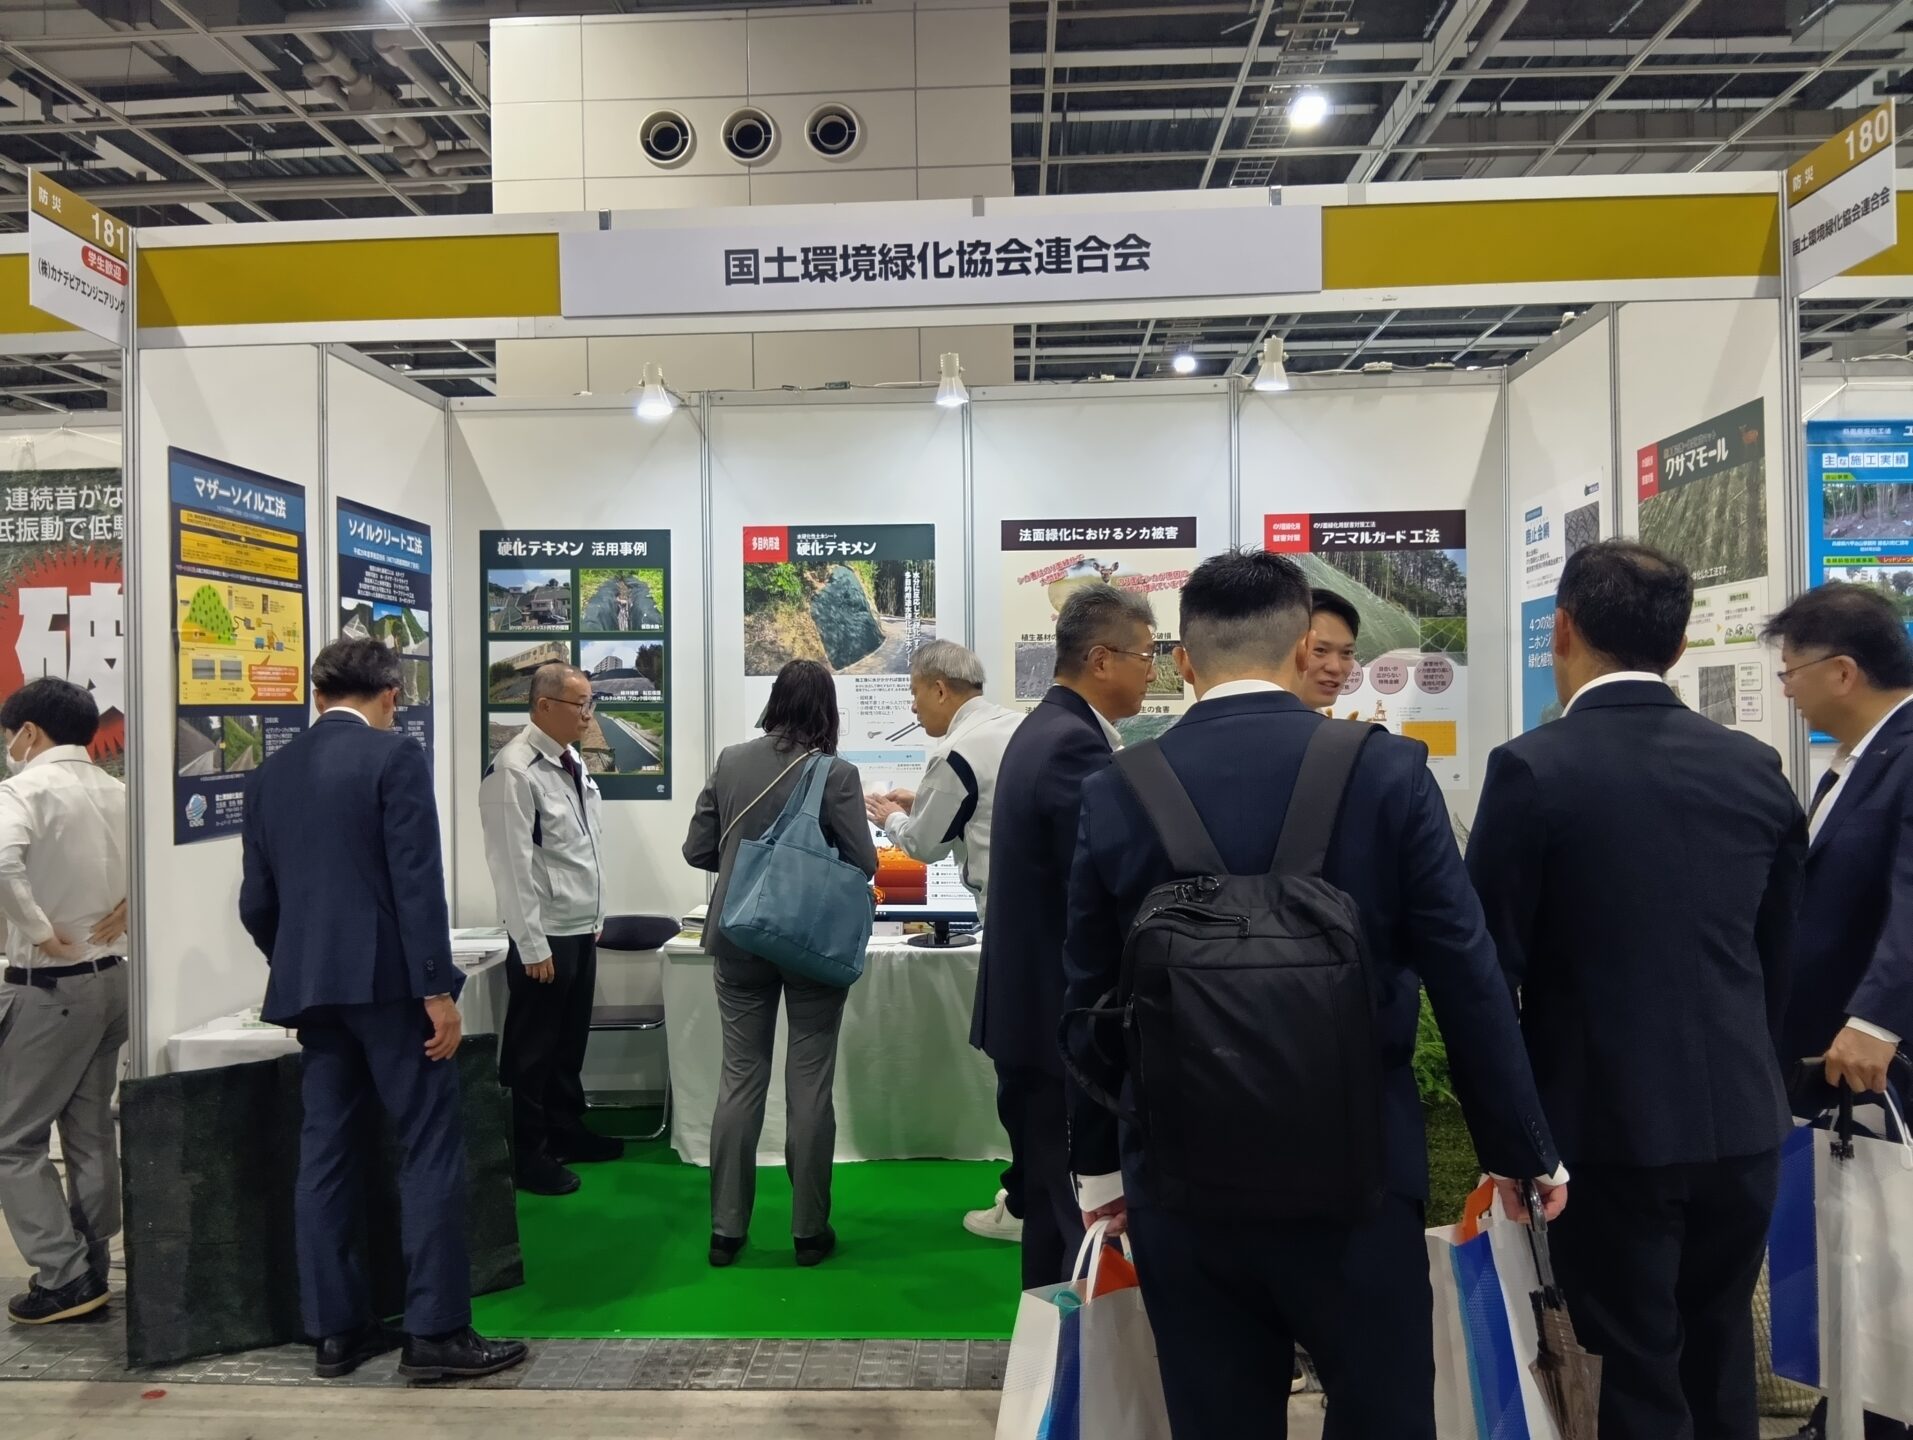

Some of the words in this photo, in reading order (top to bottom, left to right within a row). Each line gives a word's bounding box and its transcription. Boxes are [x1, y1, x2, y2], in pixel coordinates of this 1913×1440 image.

[1845, 109, 1890, 161] 180
[38, 187, 62, 213] 防災
[91, 213, 125, 254] 181
[1792, 186, 1890, 257] 国土環境緑化協会連合会
[87, 250, 122, 282] 学生歓迎
[723, 232, 1152, 287] 国土環境緑化協会連合会
[1665, 437, 1729, 480] クサマモール
[1824, 453, 1908, 467] 主な施工実績
[193, 476, 287, 519] マザーソイル工法
[348, 518, 423, 556] ソイルクリート工法
[498, 540, 584, 557] 硬化テキメン
[592, 542, 648, 557] 活用事例
[751, 536, 780, 551] 多目的用途
[796, 540, 877, 557] 硬化テキメン
[1019, 526, 1179, 542] 法面緑化におけるシカ被害
[1321, 528, 1441, 546] アニマルガード工法
